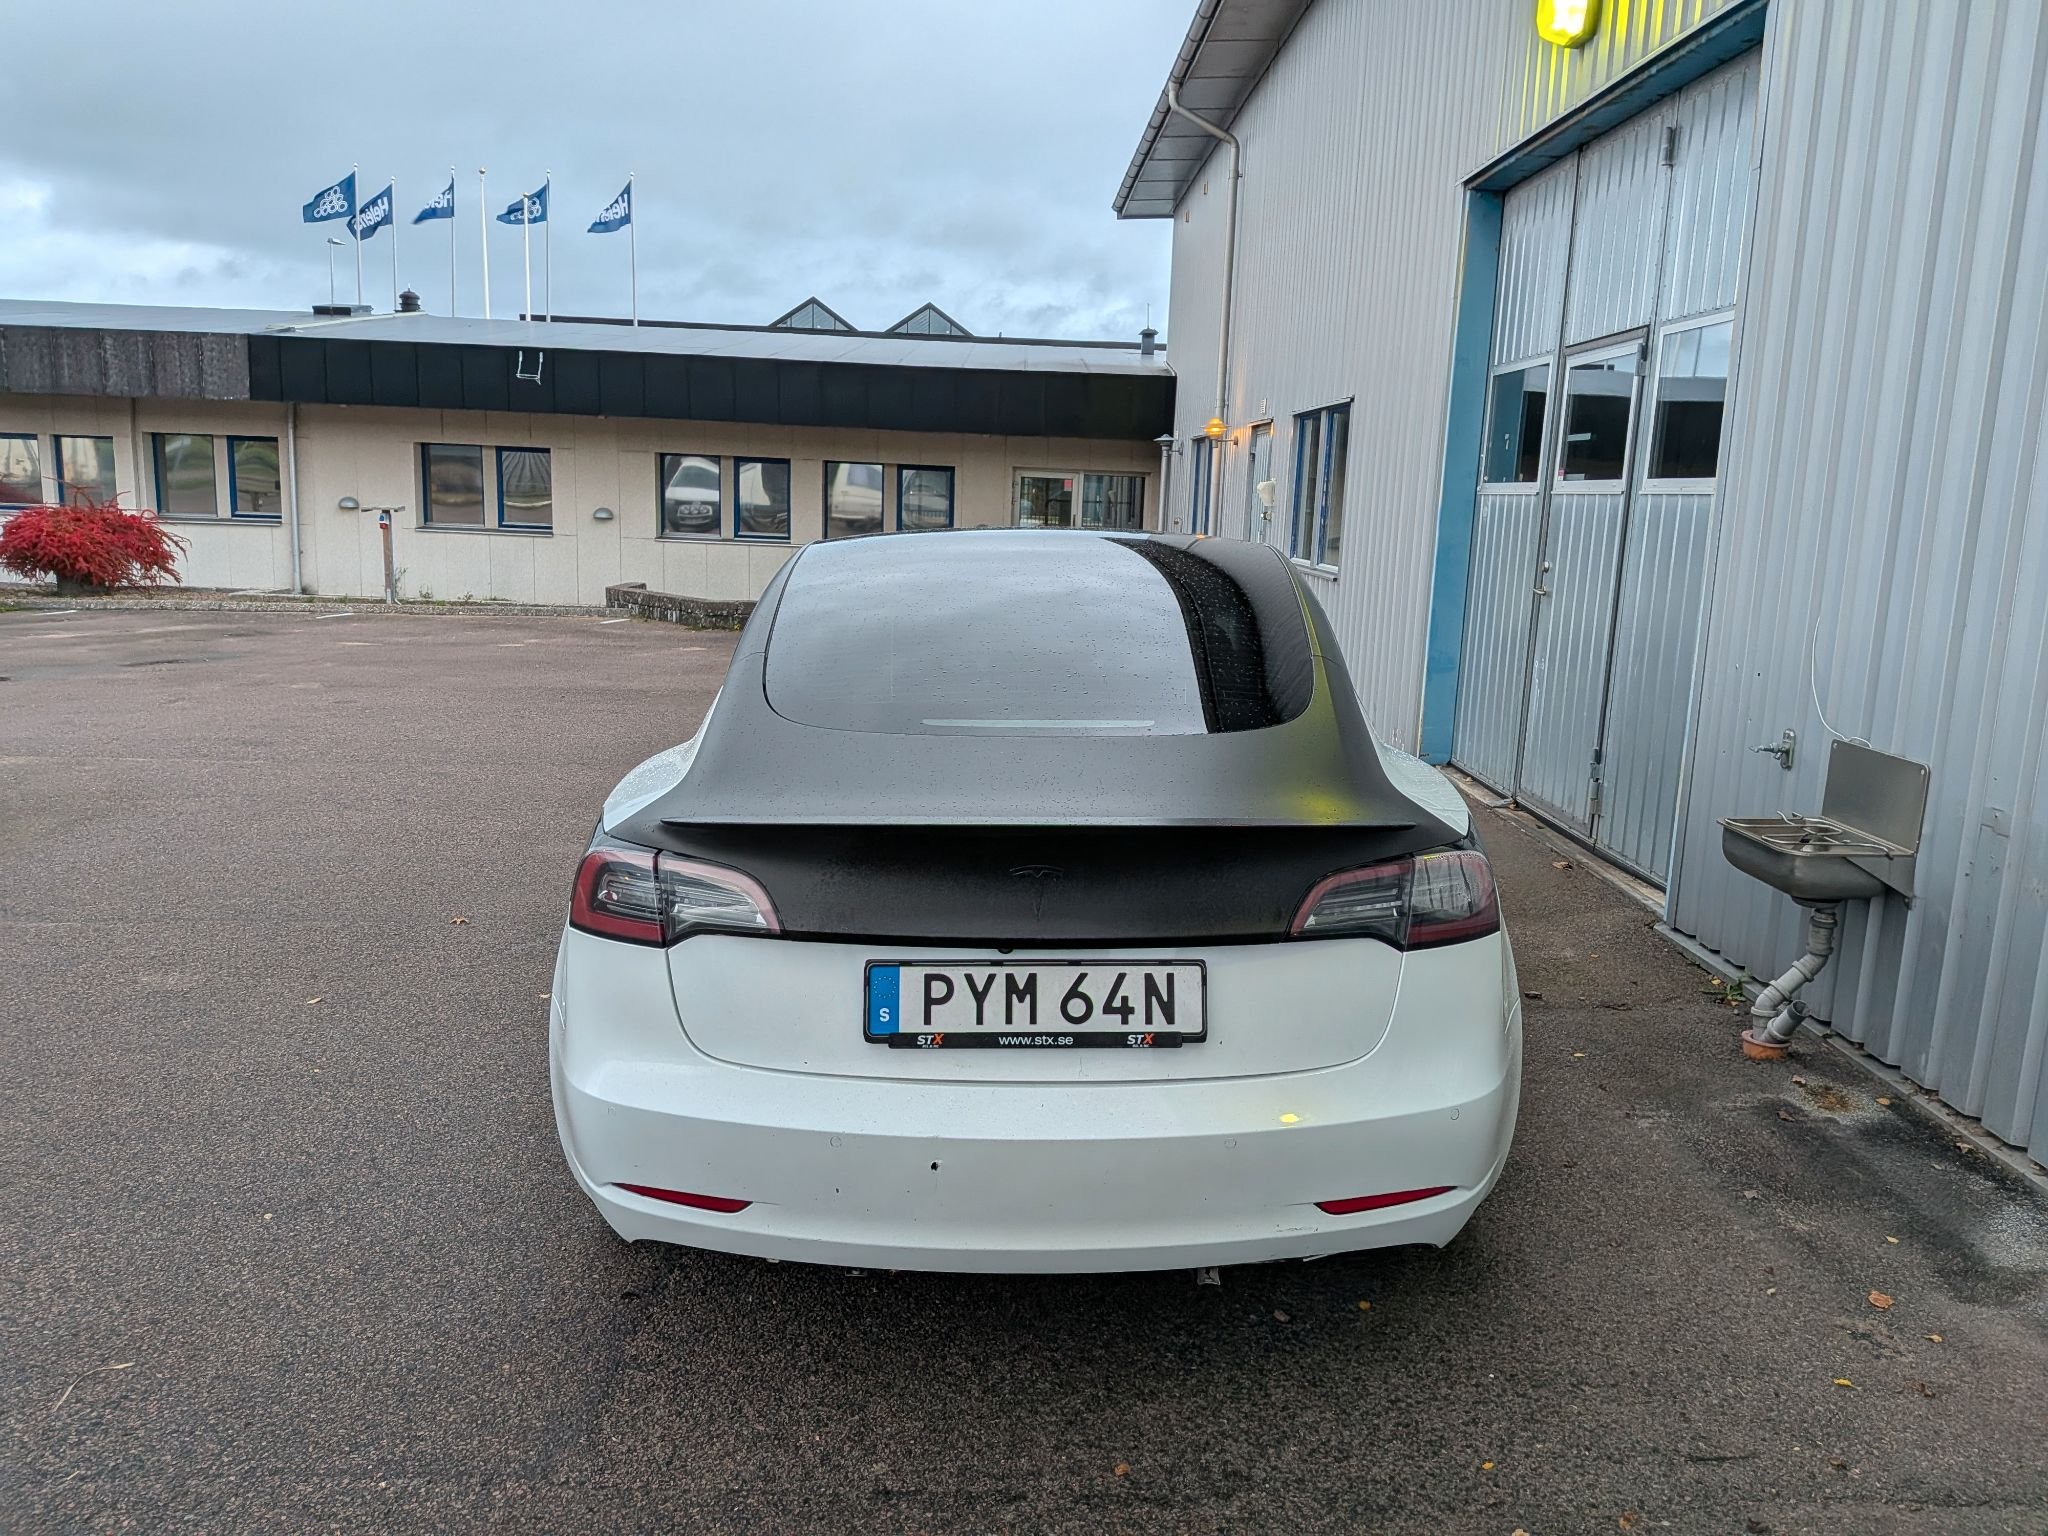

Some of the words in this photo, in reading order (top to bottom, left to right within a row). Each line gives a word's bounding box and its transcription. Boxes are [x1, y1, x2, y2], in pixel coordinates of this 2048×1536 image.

[923, 972, 1038, 1026] PYM
[1059, 972, 1176, 1026] 64N
[879, 1007, 890, 1022] S
[916, 1033, 945, 1045] STX
[998, 1035, 1074, 1046] www.stx.se
[1126, 1033, 1155, 1045] STX
